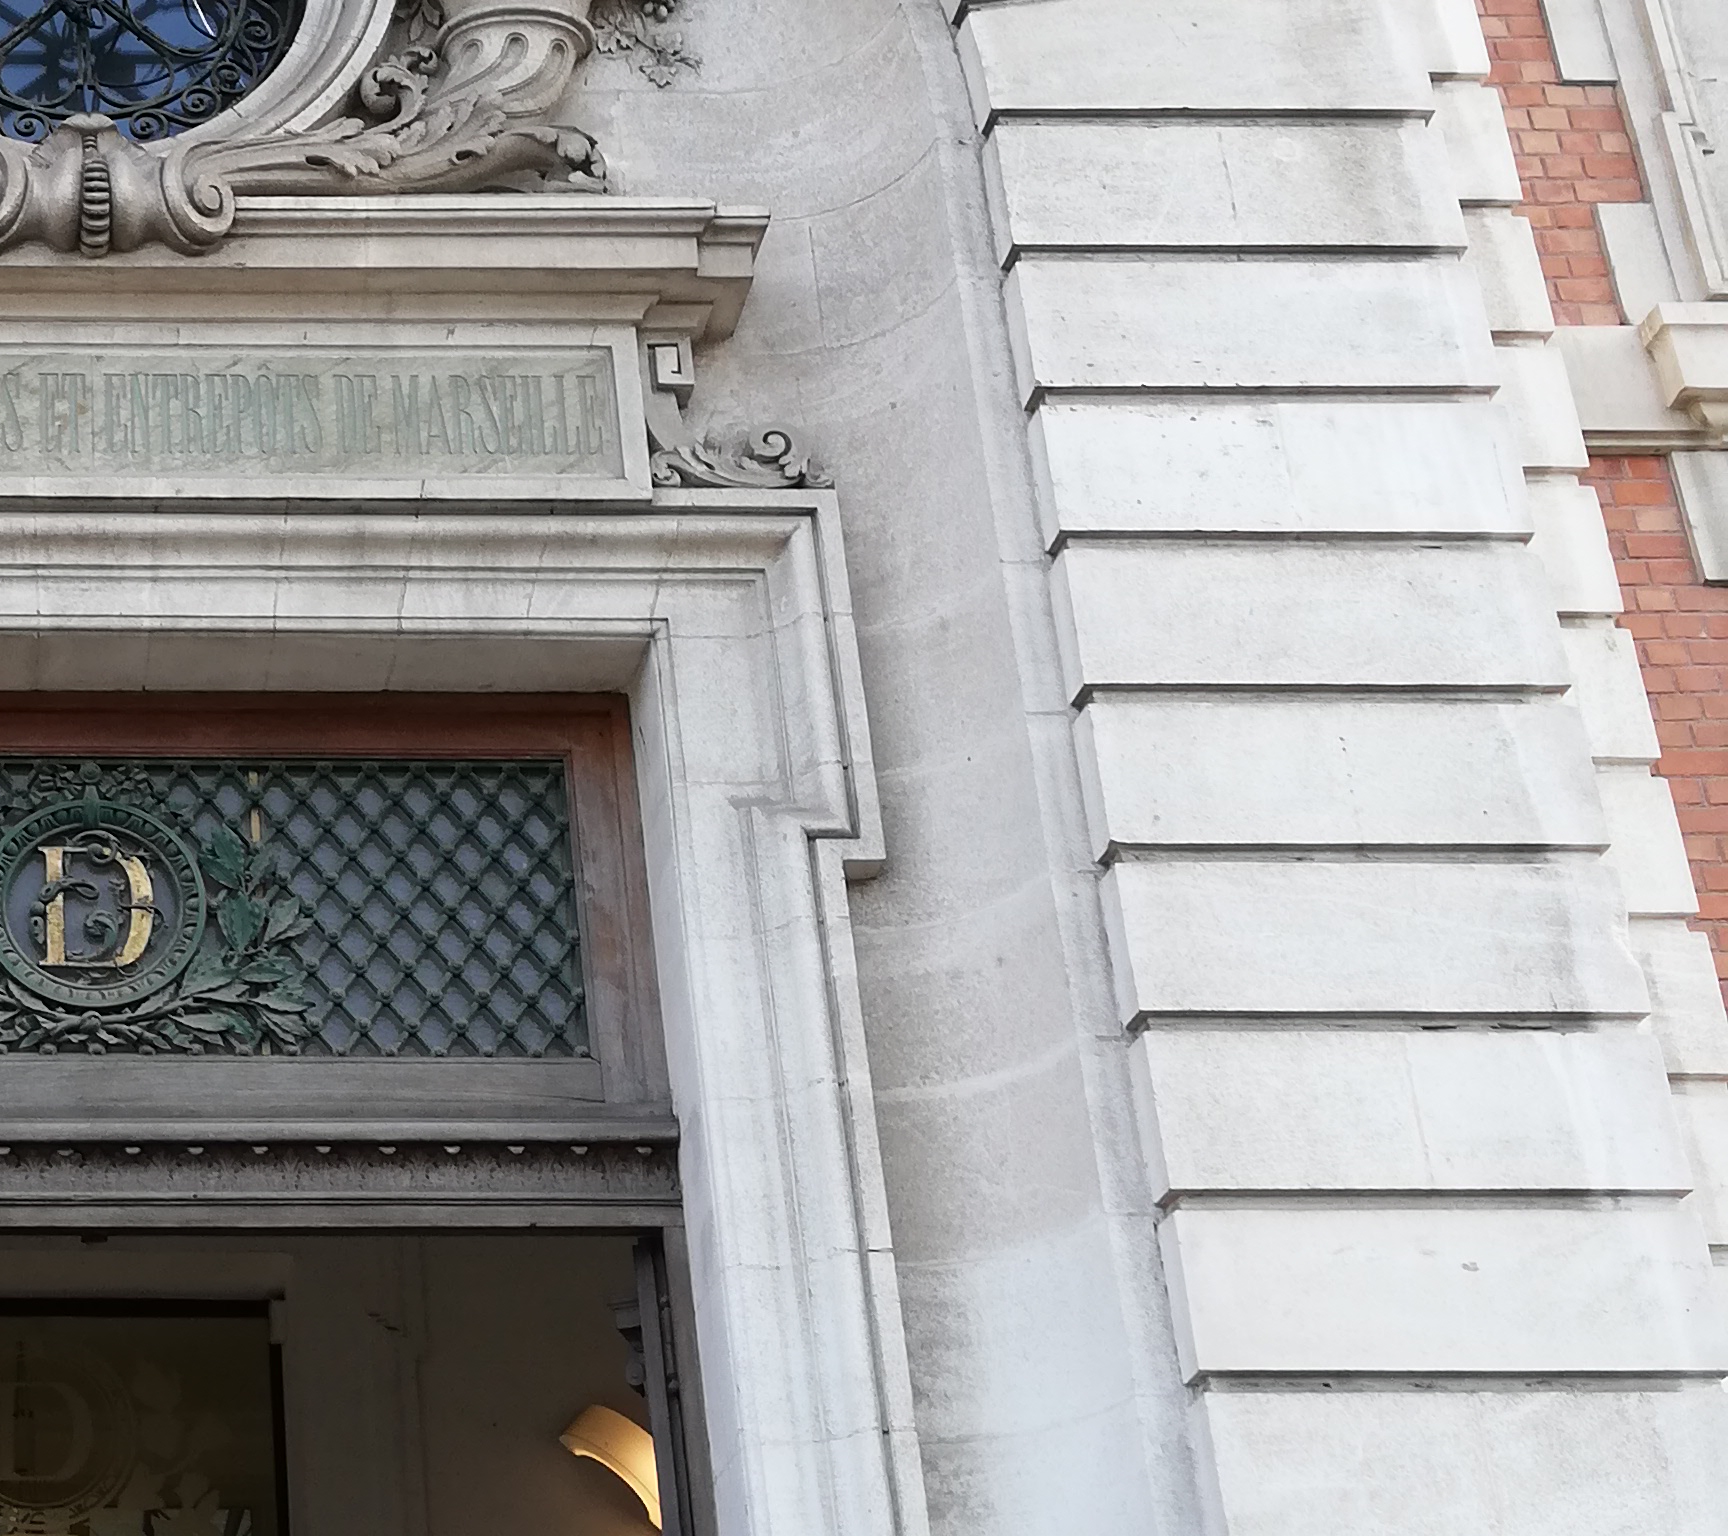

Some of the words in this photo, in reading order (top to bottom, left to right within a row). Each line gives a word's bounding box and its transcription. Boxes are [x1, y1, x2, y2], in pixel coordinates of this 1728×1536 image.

[38, 371, 86, 453] ET
[103, 364, 325, 455] ENTREPÔTS
[334, 372, 379, 455] DE
[391, 373, 605, 456] MARSEILLE
